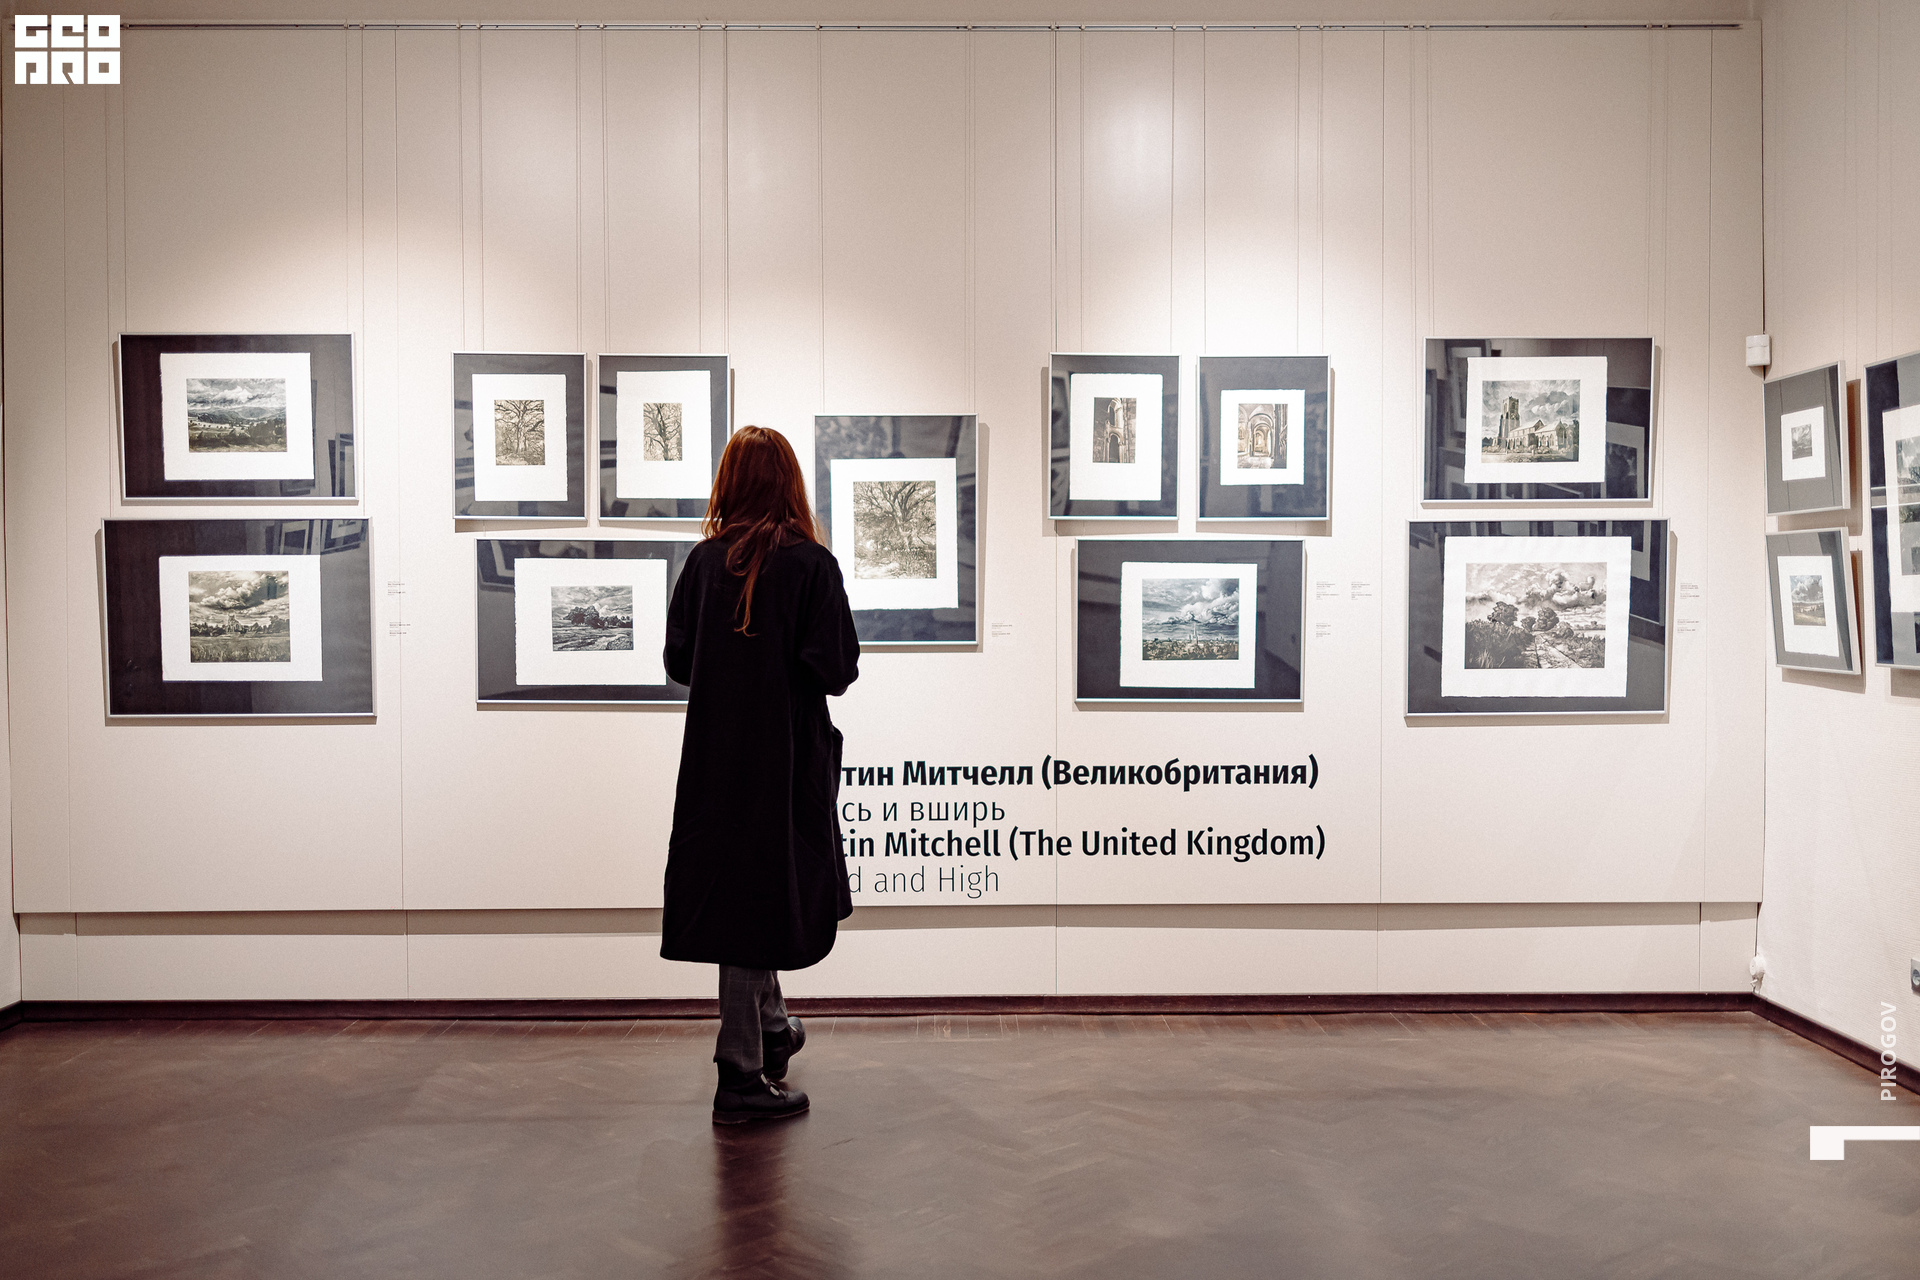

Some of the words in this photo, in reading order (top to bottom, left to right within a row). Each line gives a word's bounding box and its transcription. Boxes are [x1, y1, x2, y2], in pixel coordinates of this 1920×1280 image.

[903, 760, 1033, 786] Митчелл
[1042, 754, 1319, 792] (Великобритания)
[836, 802, 872, 822] сь
[883, 802, 898, 822] и
[910, 801, 1006, 828] вширь
[884, 827, 1001, 857] Mitchell
[1009, 826, 1073, 861] (The
[1082, 827, 1177, 856] United
[1187, 825, 1326, 862] Kingdom)
[874, 865, 925, 893] and
[939, 864, 999, 899] High
